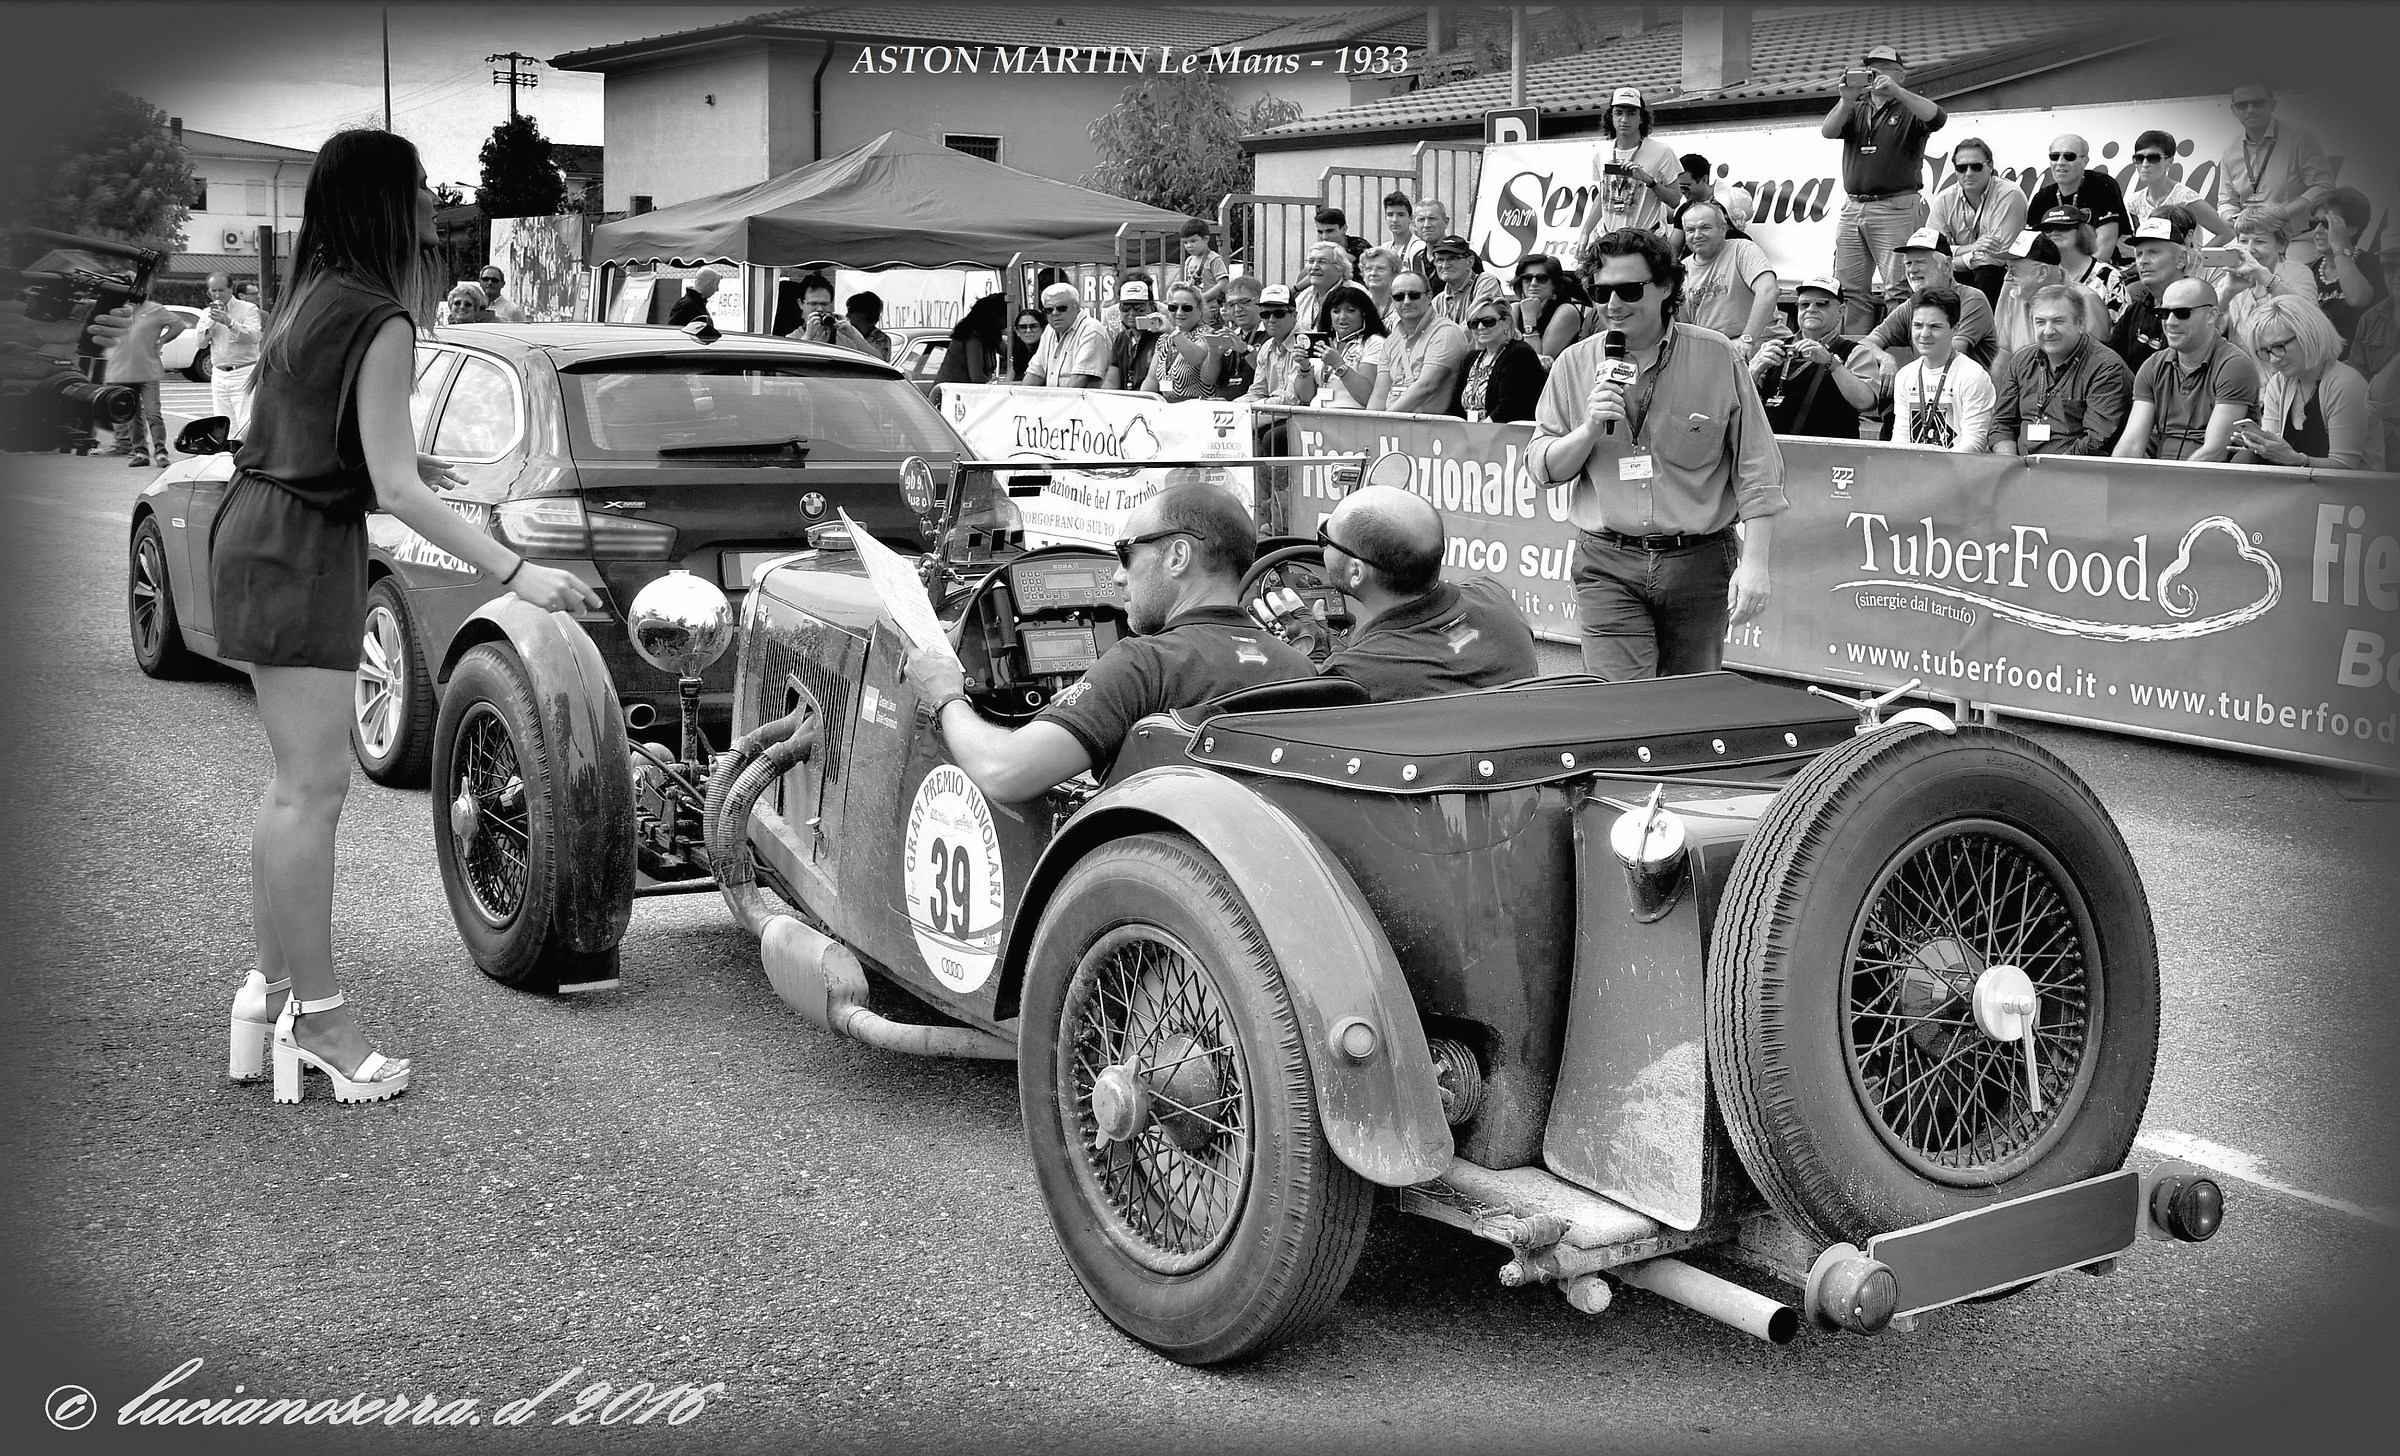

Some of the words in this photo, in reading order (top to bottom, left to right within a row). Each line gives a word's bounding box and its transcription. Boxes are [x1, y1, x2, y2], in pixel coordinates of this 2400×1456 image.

[1012, 415, 1119, 458] TuberFood
[1095, 488, 1110, 510] del
[1519, 540, 1575, 581] sul
[1845, 511, 2151, 602] TuberFood
[2313, 503, 2400, 612] Fie
[1855, 592, 1907, 610] (sinergie
[1910, 594, 1929, 612] dal
[1931, 600, 1977, 627] tartufo)
[1847, 642, 2097, 699] www.tuberfood.it
[907, 801, 925, 873] GRAN
[923, 770, 964, 808] PREMIO
[966, 786, 1002, 908] NUVOLARI
[930, 837, 970, 941] 39
